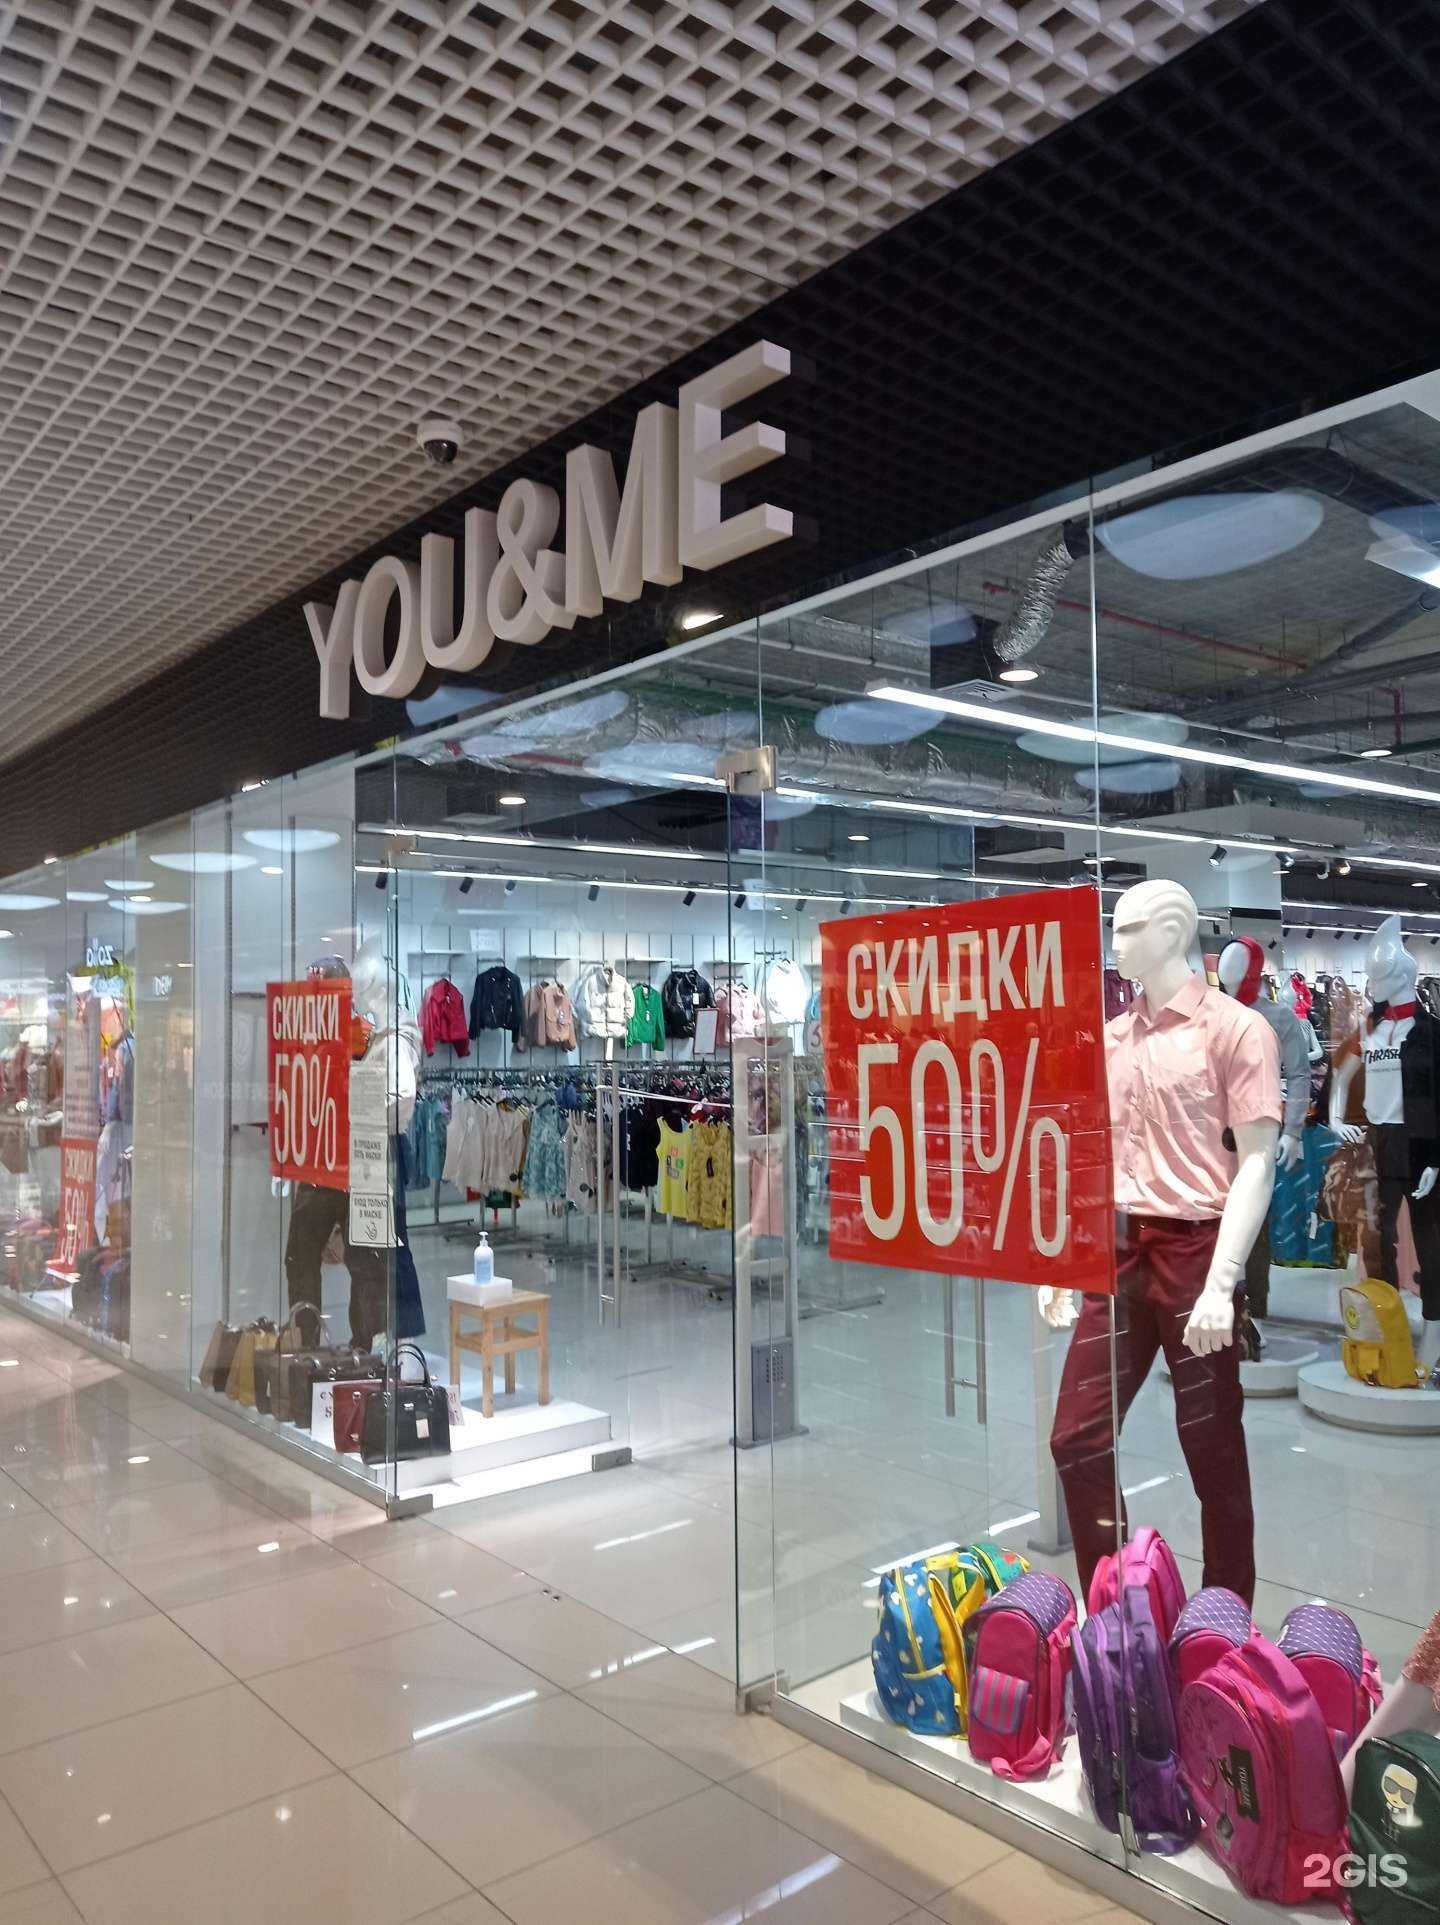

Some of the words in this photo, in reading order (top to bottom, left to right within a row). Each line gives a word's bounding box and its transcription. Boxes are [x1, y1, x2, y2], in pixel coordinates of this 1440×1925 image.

[302, 339, 793, 720] YOU&ME
[273, 994, 340, 1045] СКИДКИ
[847, 921, 1065, 1022] СКИДКИ
[65, 1147, 94, 1184] СКИДКИ
[275, 1053, 336, 1171] 50%
[857, 1037, 1068, 1257] 50%
